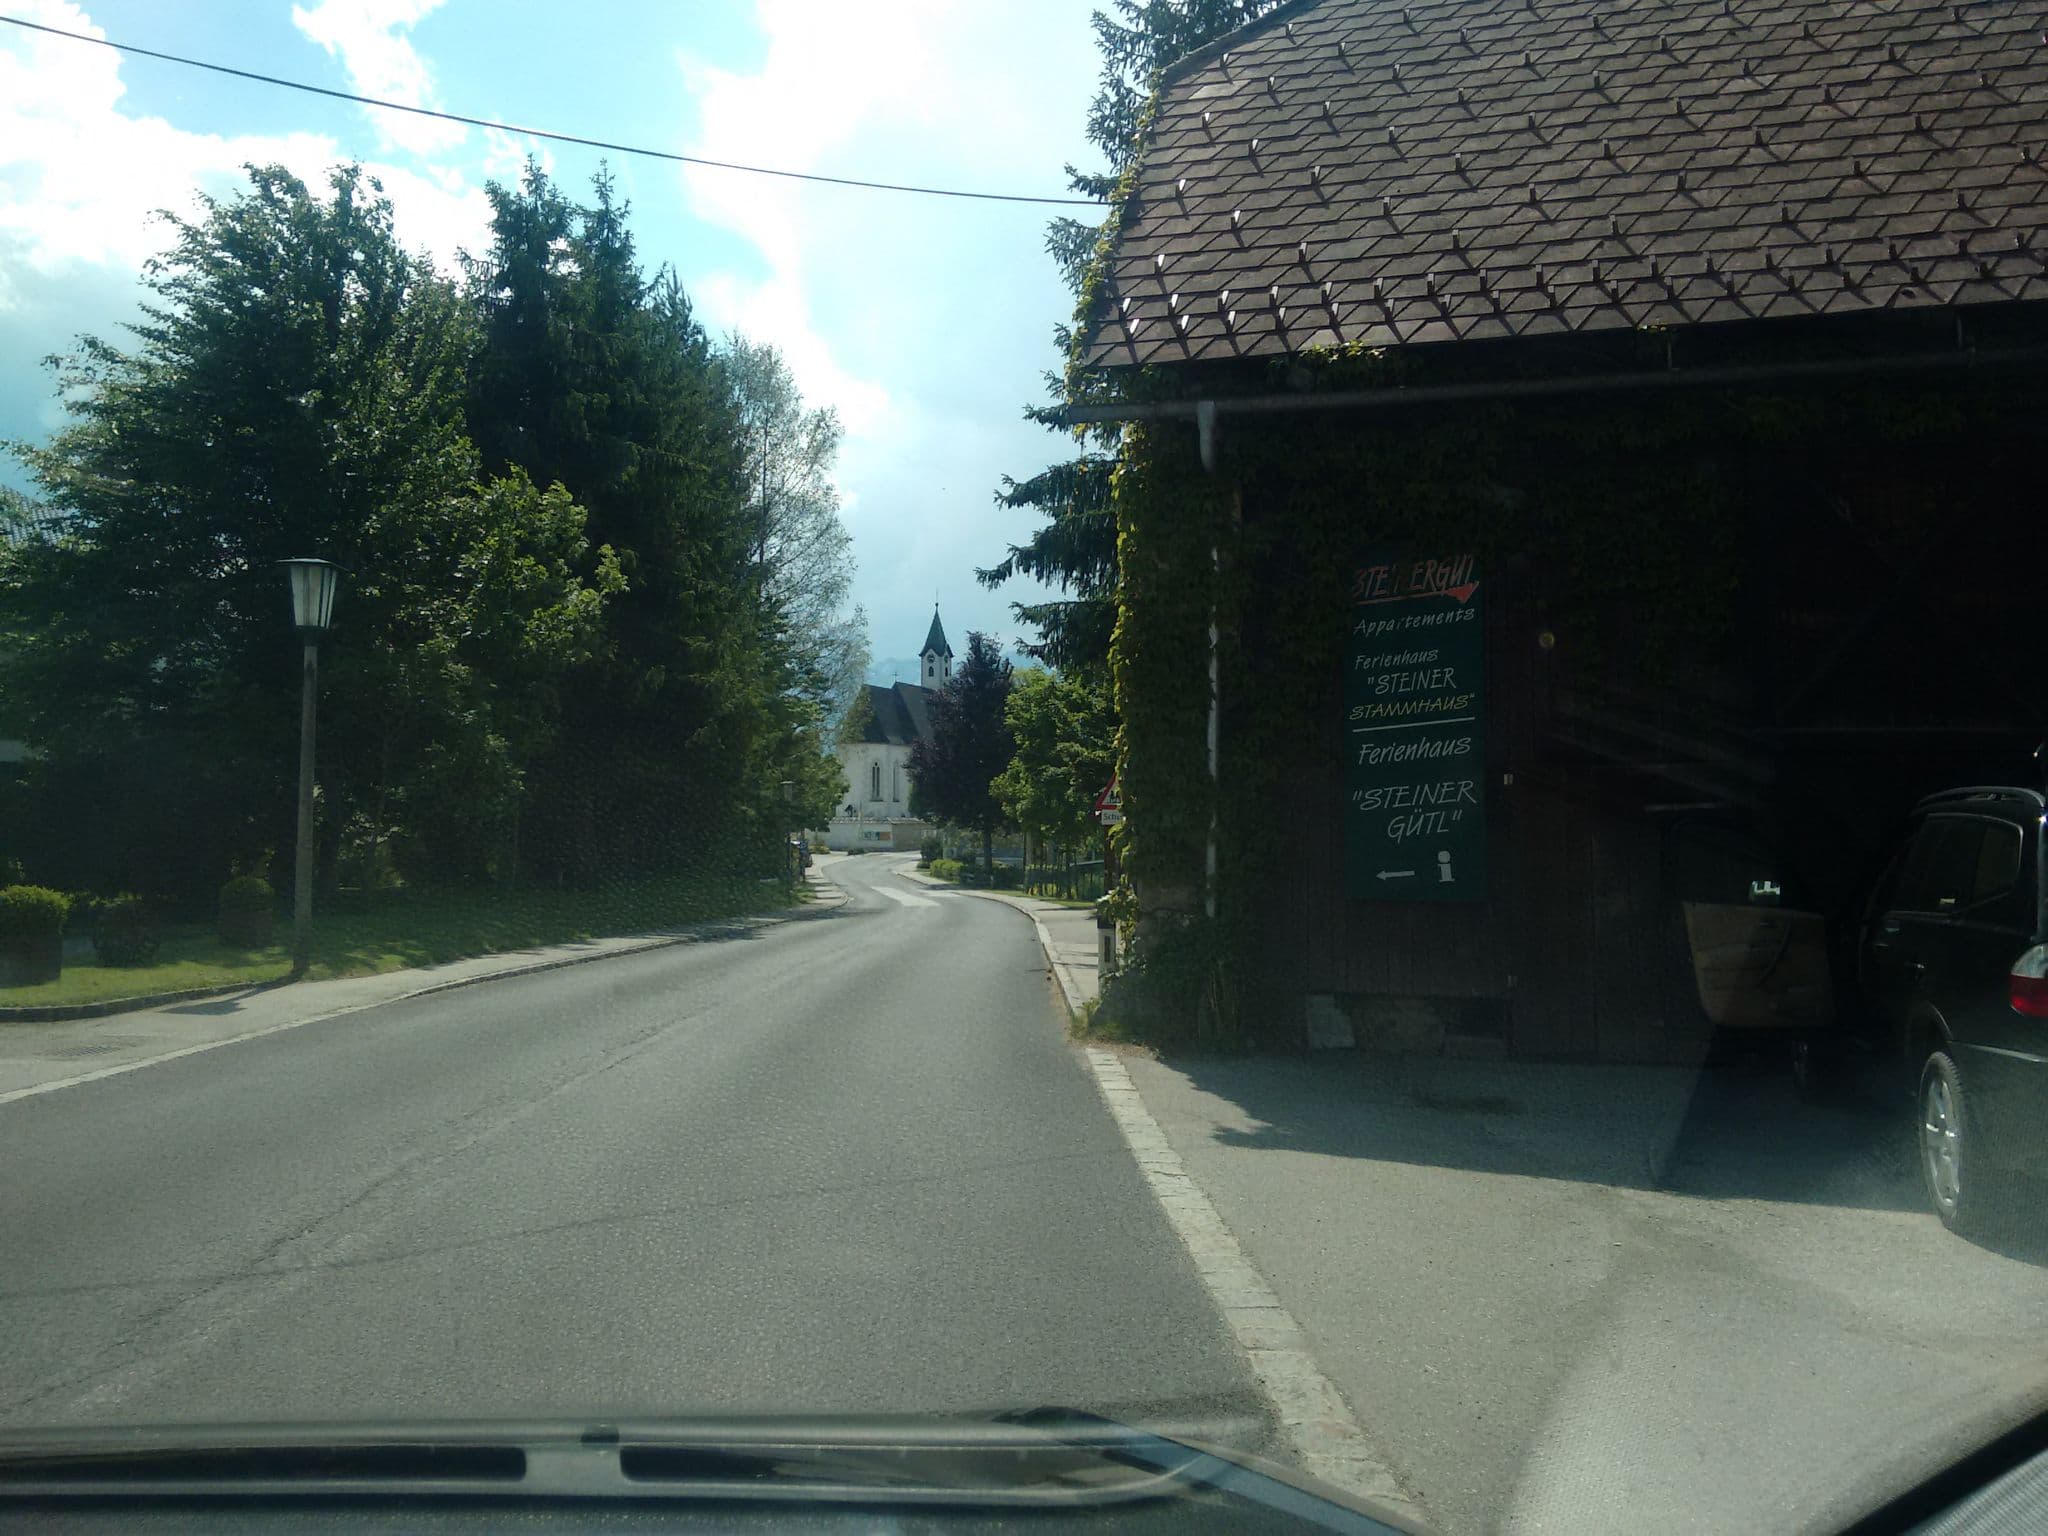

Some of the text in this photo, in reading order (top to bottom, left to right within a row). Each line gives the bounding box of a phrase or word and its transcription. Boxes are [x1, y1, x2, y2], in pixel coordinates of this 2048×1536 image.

[1353, 608, 1475, 637] Appartements
[1355, 649, 1439, 670] Ferienhaus
[1368, 667, 1457, 696] "STEINER
[1349, 693, 1475, 720] STAMMHAUS"
[1358, 736, 1472, 765] Ferienhaus
[1352, 780, 1477, 810] "STEINER
[1387, 808, 1463, 844] GÜTL"
